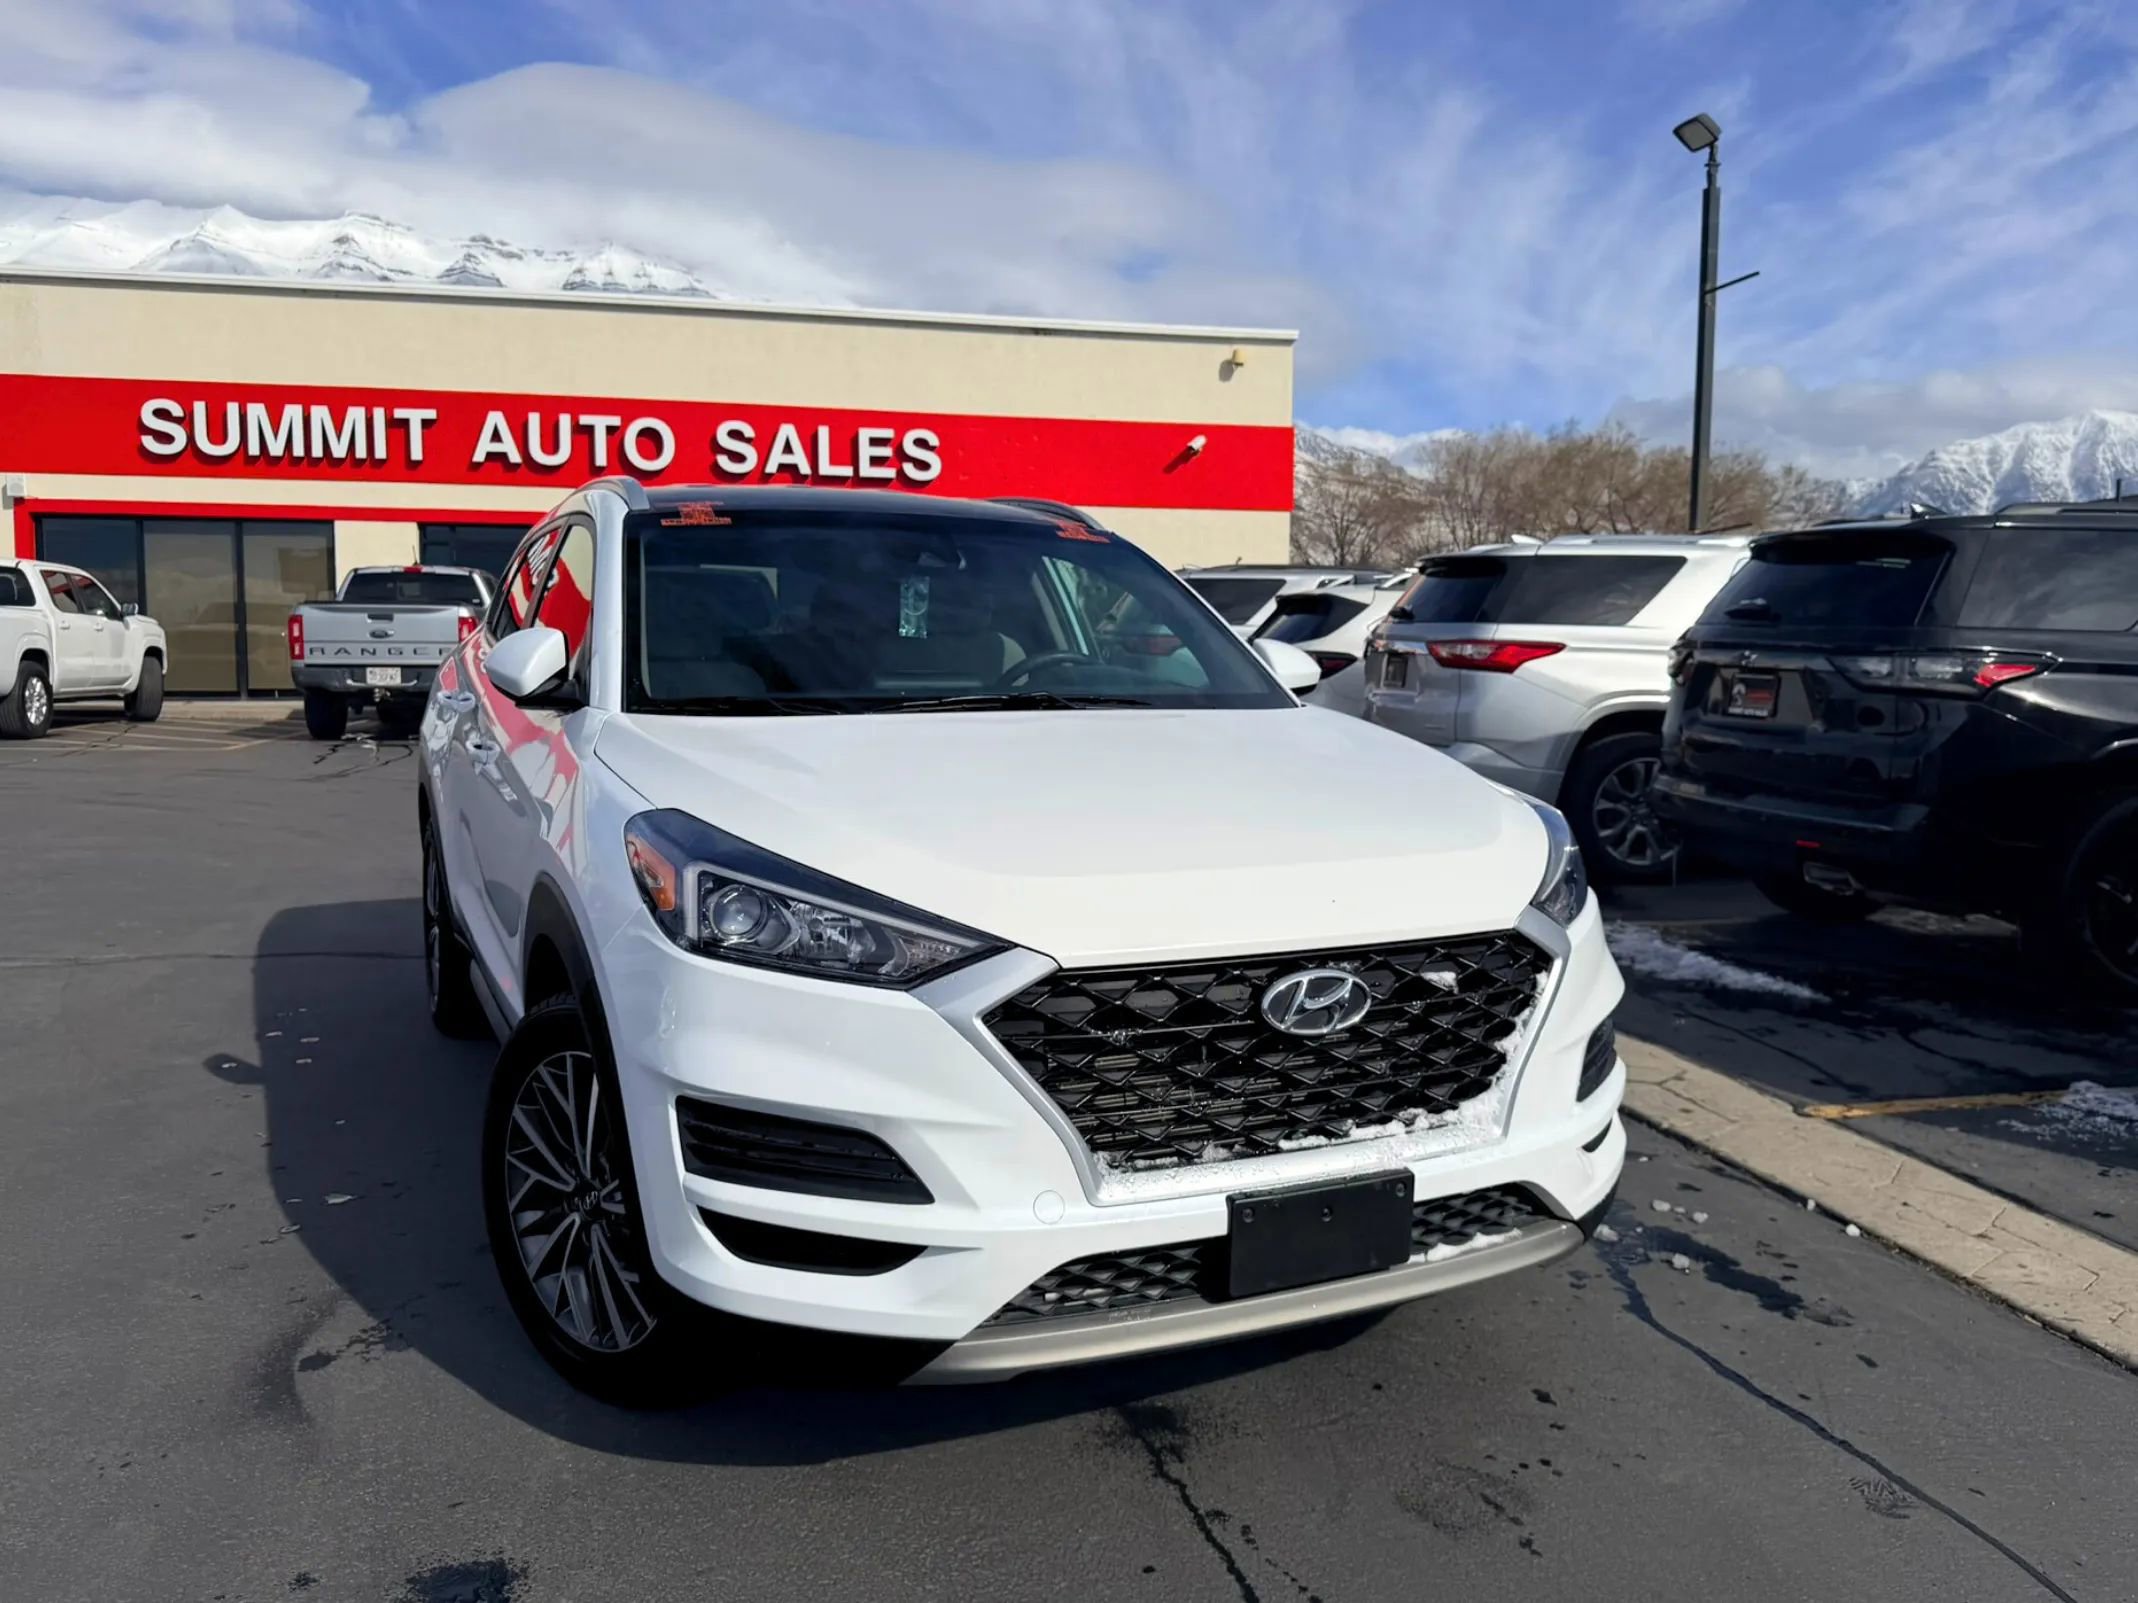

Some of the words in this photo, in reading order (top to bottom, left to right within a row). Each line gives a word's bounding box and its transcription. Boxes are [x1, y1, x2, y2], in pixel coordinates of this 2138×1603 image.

[140, 398, 437, 461] SUMMIT
[472, 411, 676, 472] AUTO
[715, 420, 942, 482] SALES
